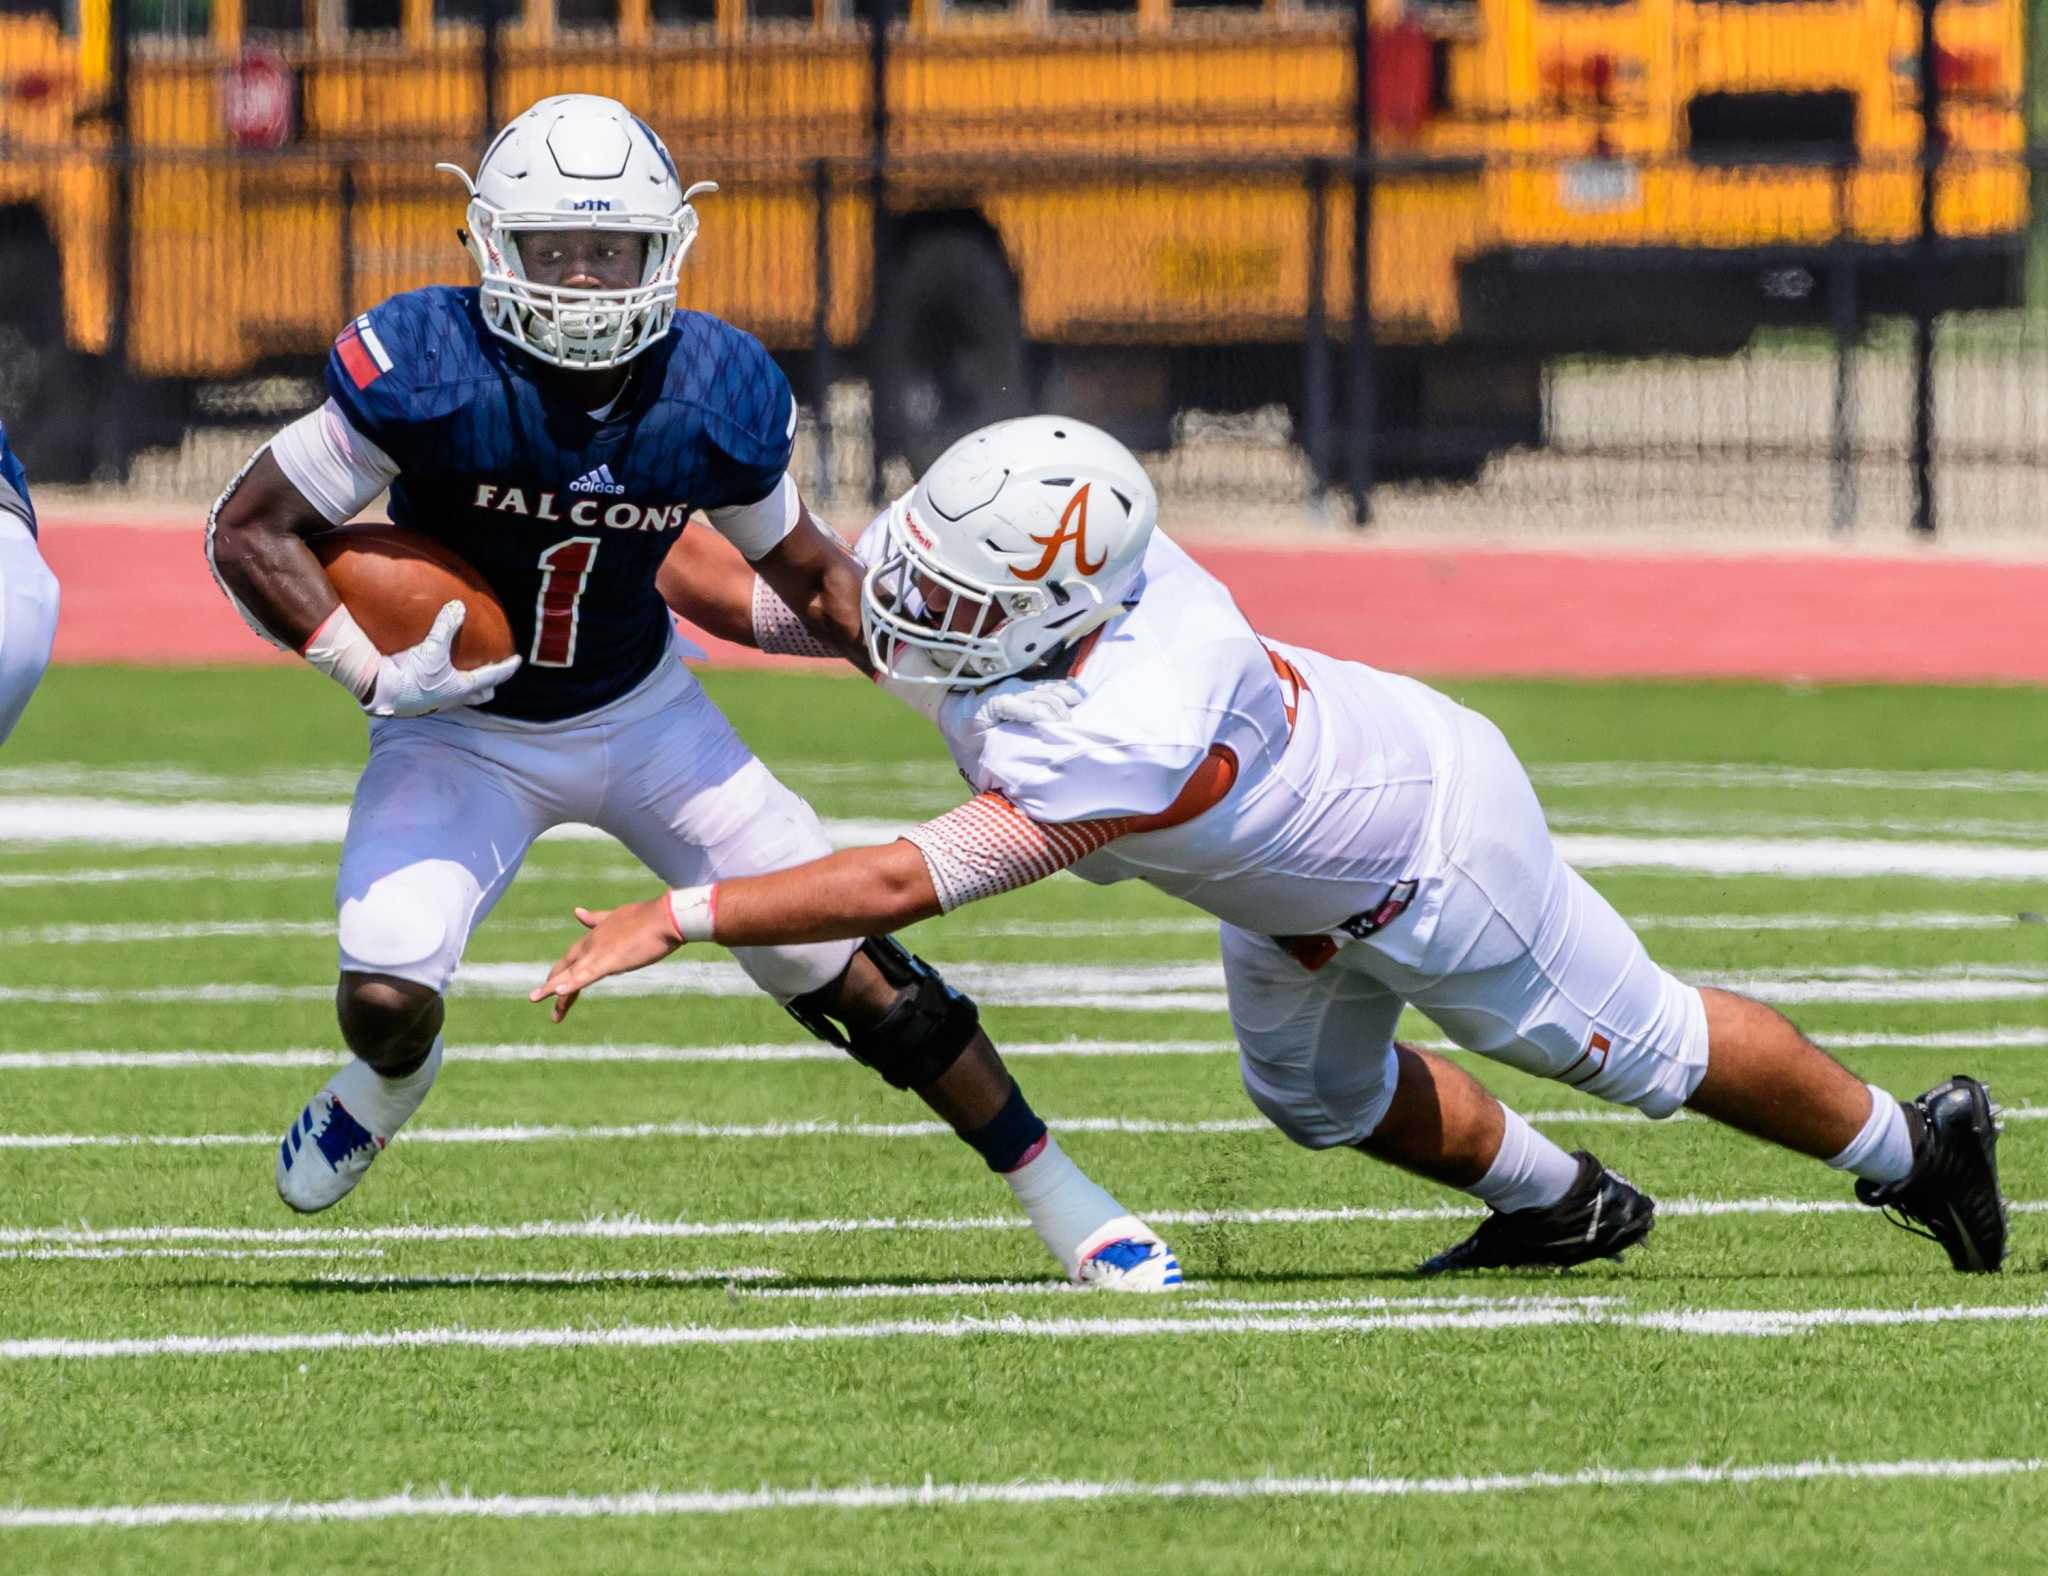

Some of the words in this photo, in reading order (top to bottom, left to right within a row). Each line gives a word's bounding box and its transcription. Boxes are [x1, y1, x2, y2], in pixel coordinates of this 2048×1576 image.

[473, 484, 688, 532] FALCONS
[569, 480, 625, 495] adidas
[1008, 482, 1108, 582] A
[530, 536, 601, 669] 1
